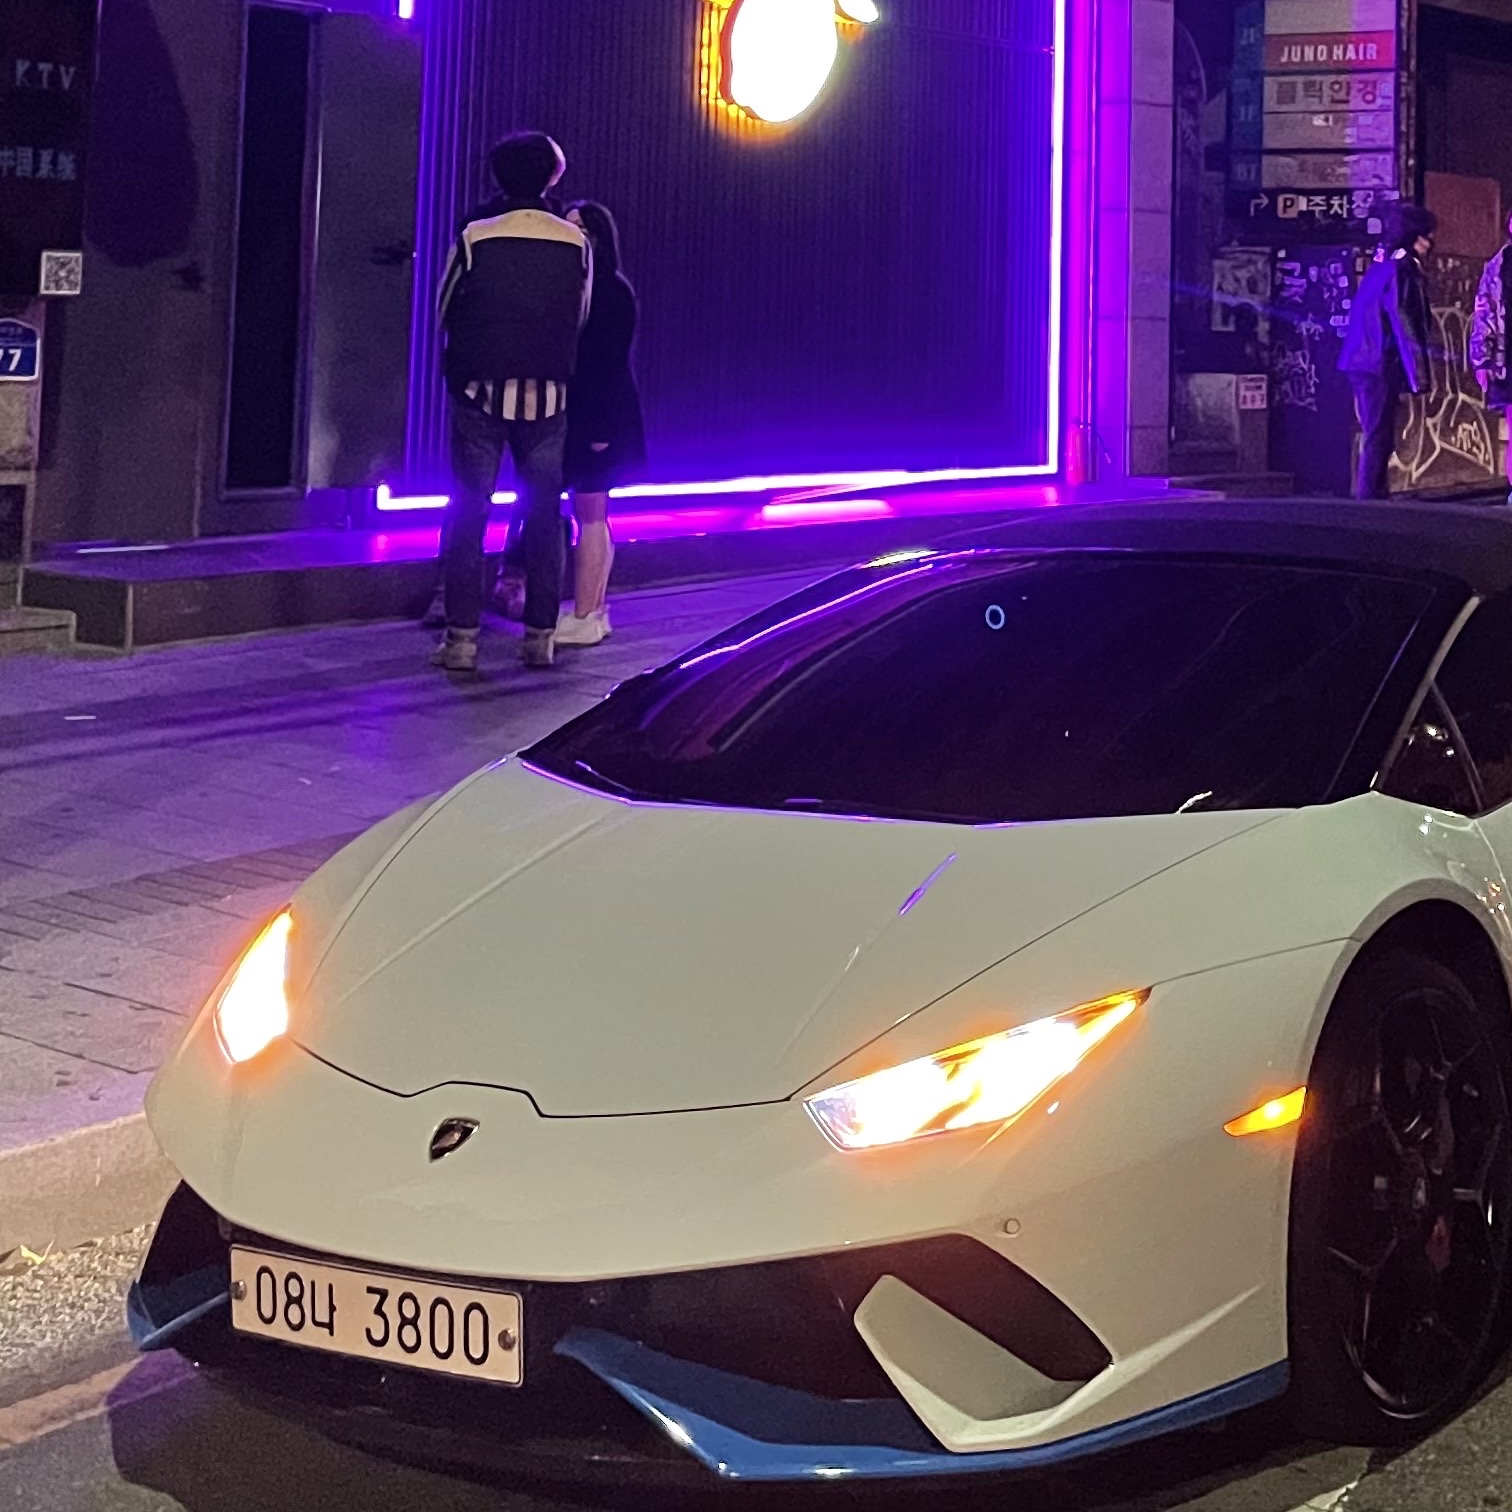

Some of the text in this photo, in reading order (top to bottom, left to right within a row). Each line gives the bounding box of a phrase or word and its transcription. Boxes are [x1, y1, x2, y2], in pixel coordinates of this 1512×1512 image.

[1280, 42, 1378, 63] JUNO HAIR
[15, 59, 76, 90] KTV
[0, 348, 22, 372] 7
[256, 1265, 490, 1366] 08나 3800
